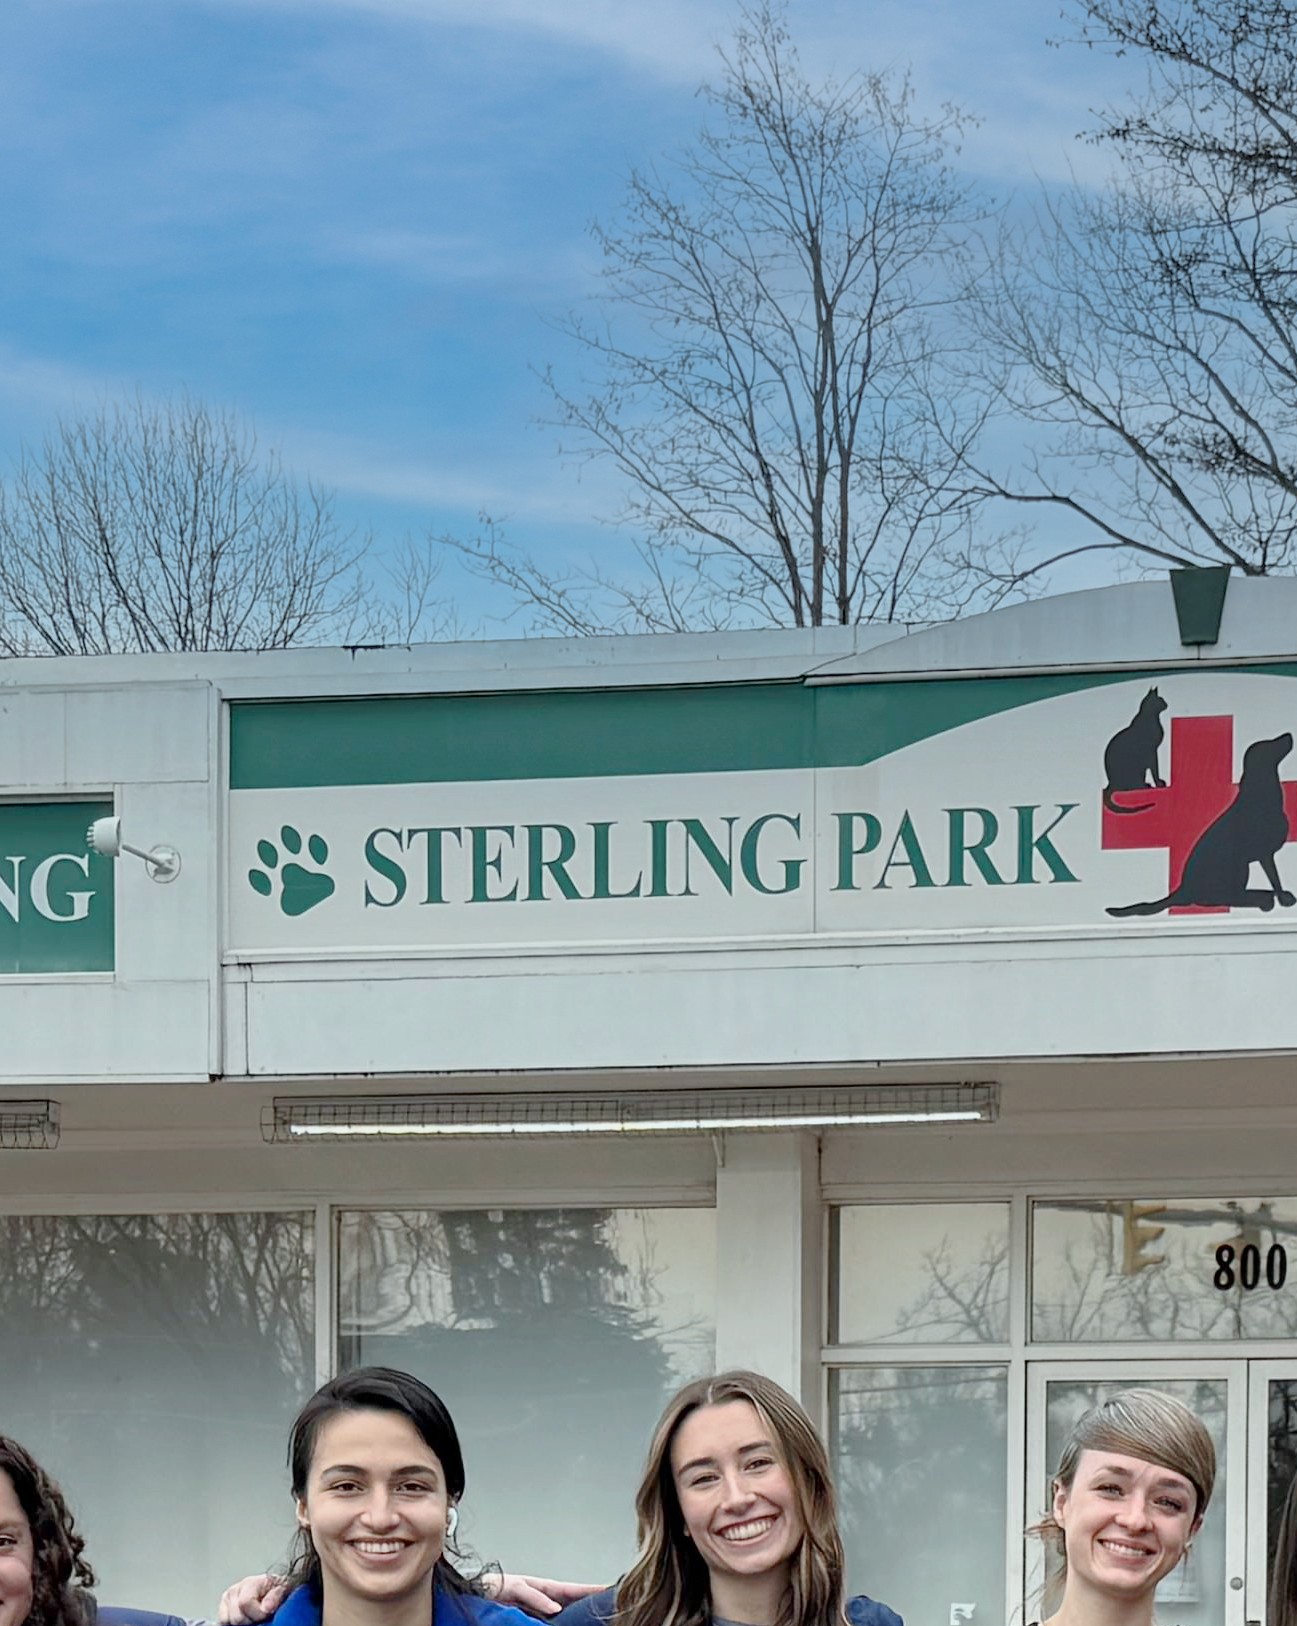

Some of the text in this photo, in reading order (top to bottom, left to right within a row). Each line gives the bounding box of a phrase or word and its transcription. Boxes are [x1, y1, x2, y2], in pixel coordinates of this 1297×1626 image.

[363, 813, 808, 908] STERLING
[831, 803, 1083, 891] PARK
[1213, 1244, 1287, 1291] 800
